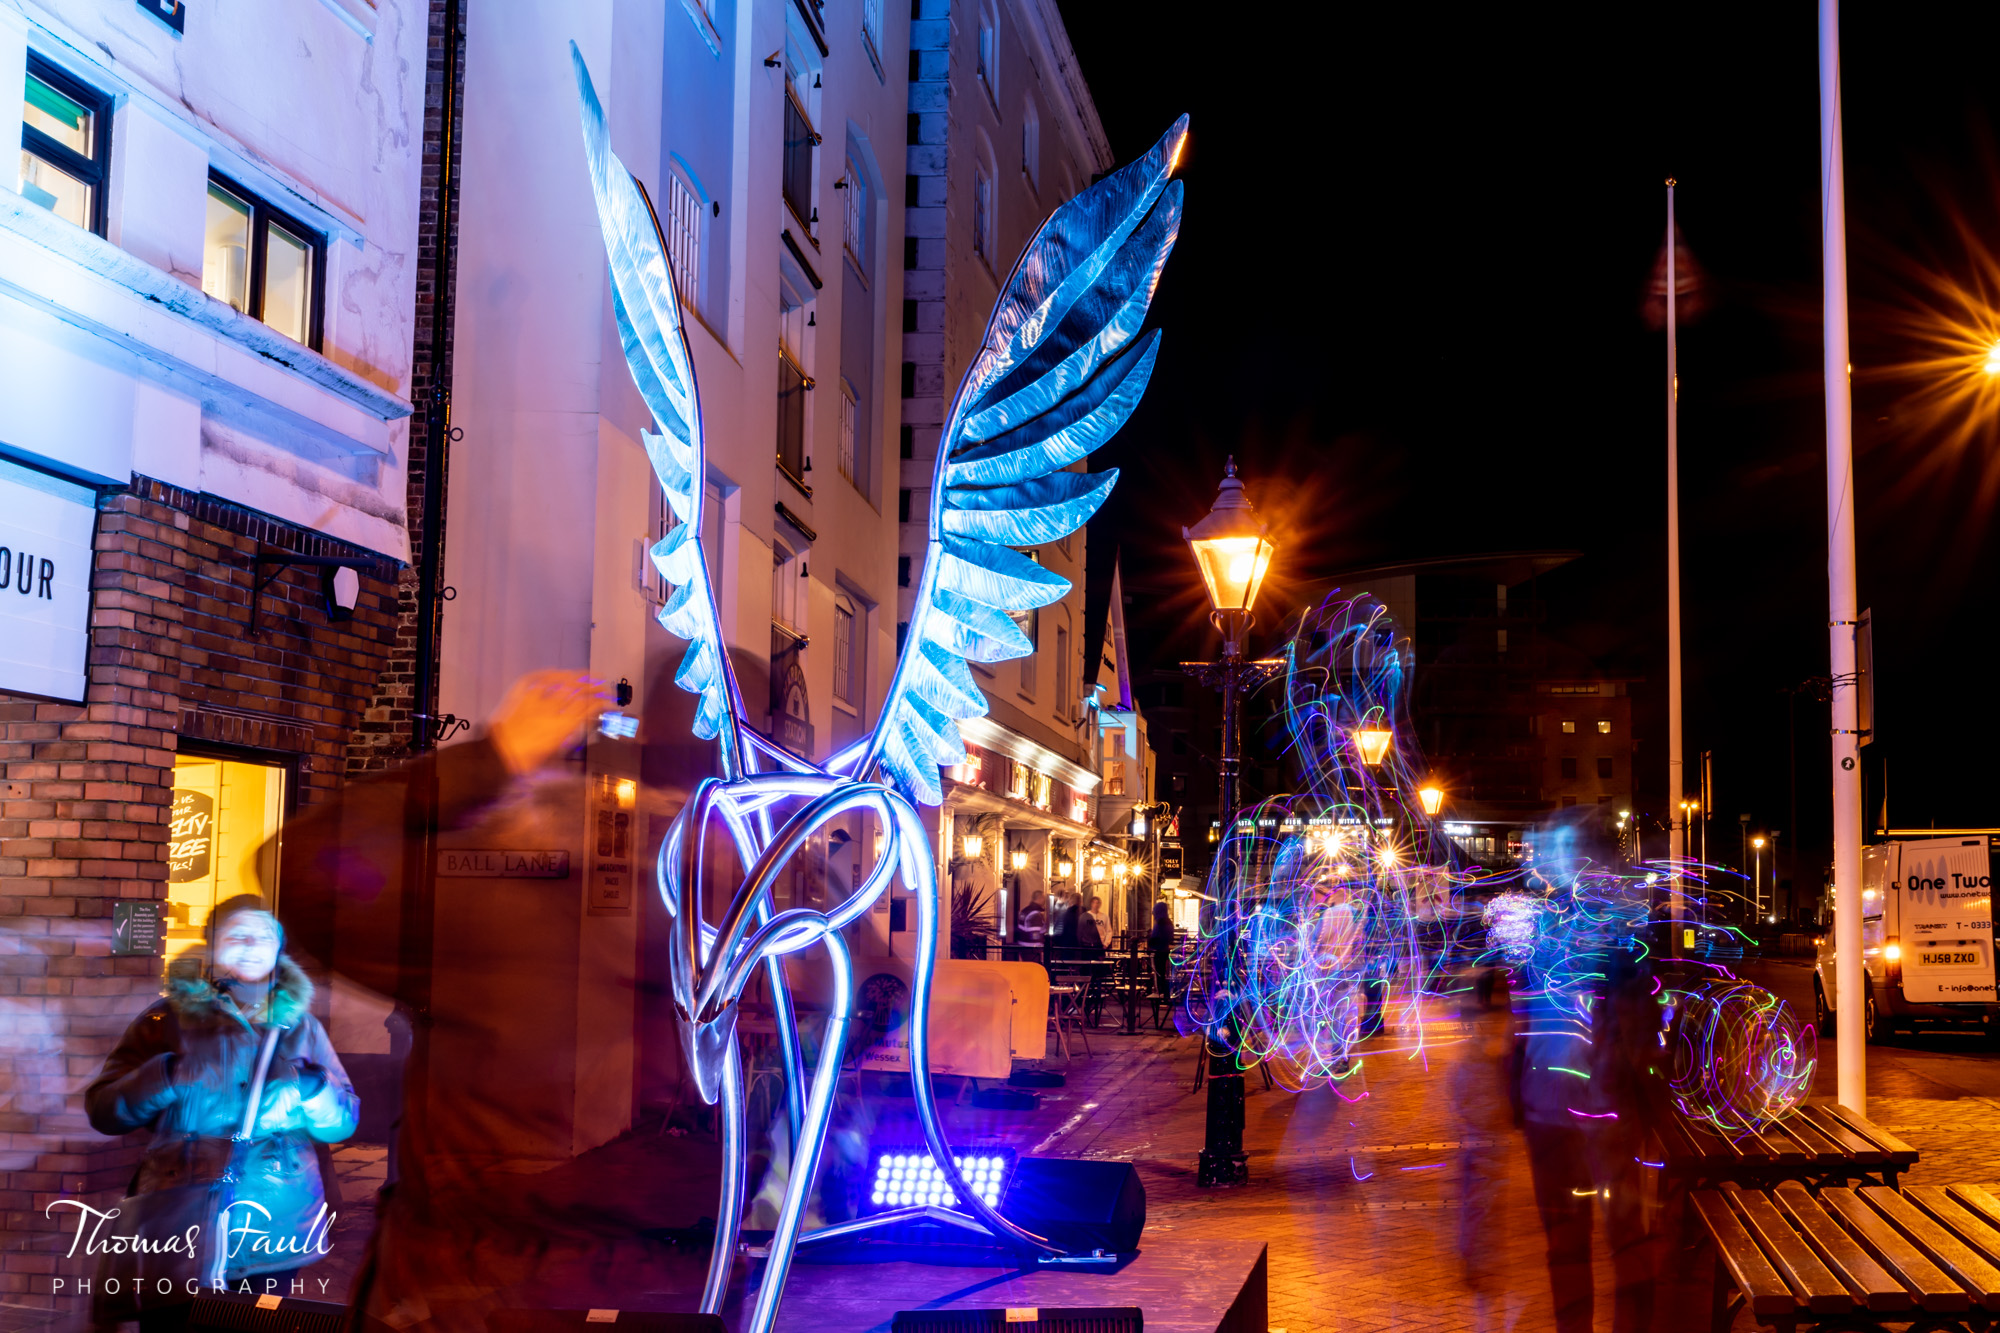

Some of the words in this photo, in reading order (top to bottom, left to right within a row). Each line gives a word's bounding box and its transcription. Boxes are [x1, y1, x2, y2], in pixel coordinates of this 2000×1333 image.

[448, 855, 495, 871] BALL
[504, 856, 557, 872] LANE
[1908, 876, 1946, 891] One
[1951, 872, 1991, 889] Two
[1923, 954, 1951, 964] HJ58
[874, 1037, 909, 1048] Mutua
[865, 1050, 901, 1062] Wessex
